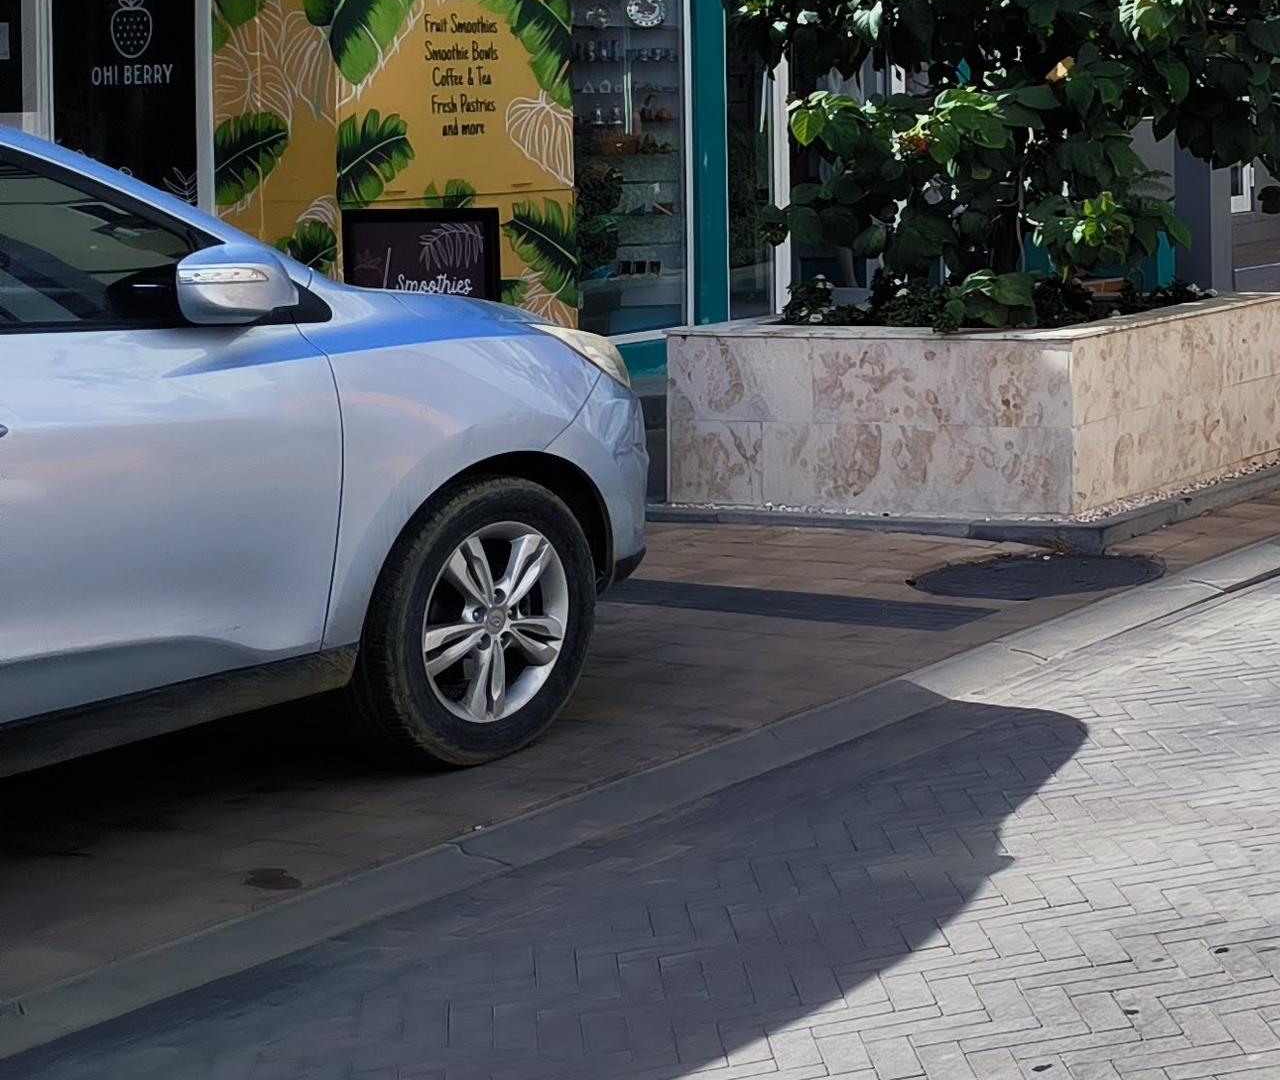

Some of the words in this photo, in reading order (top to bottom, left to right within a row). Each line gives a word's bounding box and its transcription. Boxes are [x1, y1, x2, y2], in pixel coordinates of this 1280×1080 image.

[424, 13, 448, 33] Fruit
[450, 13, 498, 34] Smoothies
[424, 40, 469, 61] Smoothie
[472, 40, 499, 61] Bowls
[91, 66, 118, 86] OH!
[124, 64, 173, 85] BERRY
[432, 66, 463, 87] Coffee
[467, 67, 474, 86] &
[476, 66, 492, 86] Tea
[431, 94, 458, 114] Fresh
[460, 93, 496, 114] Pastries
[442, 117, 458, 136] and
[461, 123, 485, 135] more
[396, 273, 473, 295] Smoothies
